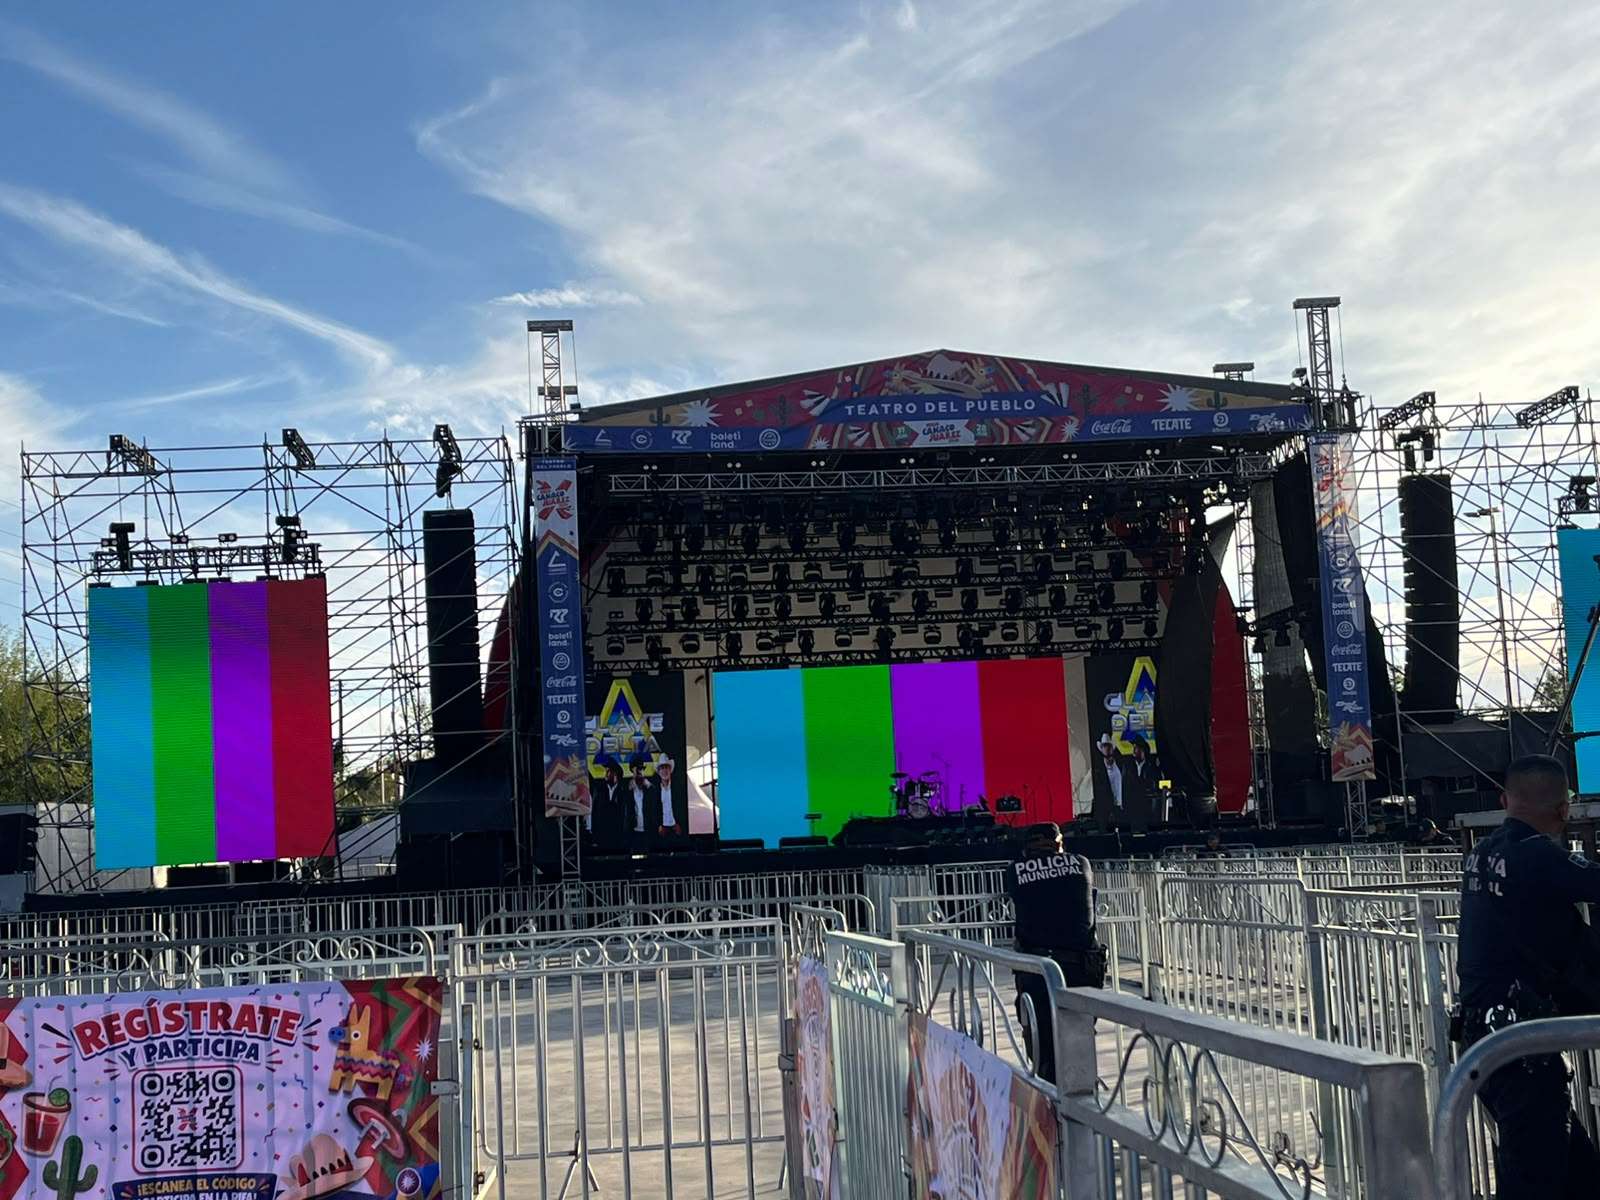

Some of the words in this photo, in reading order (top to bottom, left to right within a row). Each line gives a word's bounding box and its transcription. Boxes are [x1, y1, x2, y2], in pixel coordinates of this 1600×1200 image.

[844, 402, 917, 416] TEATRO
[925, 402, 959, 413] DEL
[966, 399, 1036, 412] PUEBLO
[1151, 418, 1192, 431] TECATE
[1331, 662, 1363, 673] TECATE
[546, 694, 577, 705] TECATE
[1018, 865, 1084, 886] MUNICIPAL
[72, 997, 302, 1057] REGÍSTRATE
[120, 1047, 137, 1068] Y
[144, 1038, 261, 1063] PARTICIPA
[137, 1179, 194, 1196] ¡ESCANEA
[196, 1178, 209, 1191] EL
[212, 1175, 257, 1190] CÓDIGO
